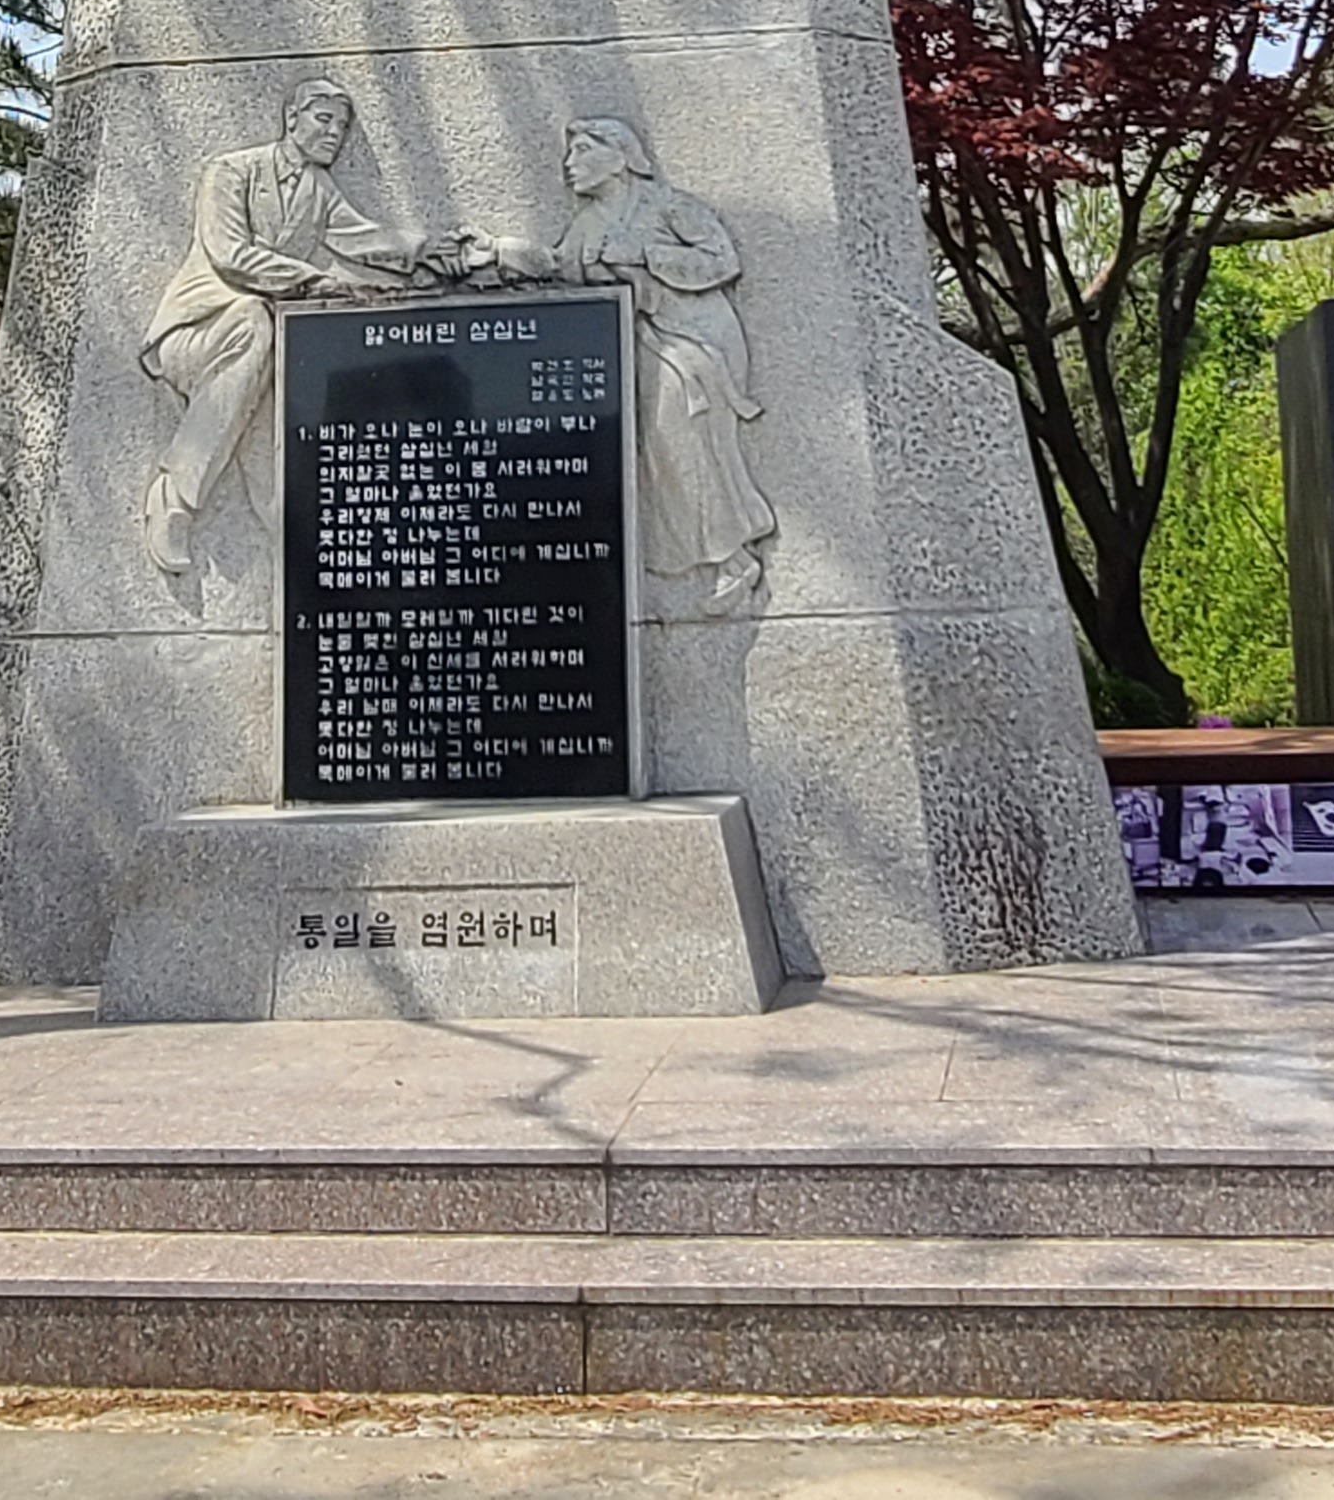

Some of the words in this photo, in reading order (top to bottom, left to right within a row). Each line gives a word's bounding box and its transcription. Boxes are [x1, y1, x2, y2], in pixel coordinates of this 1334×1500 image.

[365, 323, 457, 346] 잃어버린
[469, 319, 538, 342] 삼십년
[297, 426, 313, 441] 1.
[319, 424, 356, 439] 비가
[363, 422, 398, 438] 오나
[408, 420, 442, 437] 눈이
[453, 419, 487, 437] 오나
[497, 417, 549, 434] 바람이
[560, 415, 596, 431] 부나
[318, 444, 390, 461] 그리웠던
[400, 441, 453, 459] 삼십년
[463, 439, 498, 456] 세월
[319, 465, 390, 483] 의지할곳
[400, 463, 434, 480] 없는
[445, 461, 460, 478] 이
[471, 461, 487, 477] 몸
[498, 457, 588, 476] 서러워하며
[318, 488, 334, 504] 그
[345, 485, 399, 503] 얼마나
[408, 482, 497, 501] 울었던가요
[318, 507, 390, 525] 우리형제
[400, 504, 473, 522] 이제라도
[483, 503, 516, 519] 다시
[528, 500, 581, 517] 만나서
[318, 529, 373, 547] 못다한
[382, 527, 398, 544] 정
[408, 525, 480, 543] 나누는데
[318, 550, 372, 568] 어머님
[381, 548, 435, 566] 아버님
[445, 547, 461, 564] 그
[472, 544, 525, 562] 어디에
[536, 542, 610, 561] 계십니까
[318, 571, 390, 589] 목메이게
[400, 569, 435, 587] 불러
[445, 567, 501, 586] 봅니다
[296, 614, 312, 629] 2.
[318, 611, 391, 629] 내일일까
[400, 607, 474, 627] 모레일까
[483, 607, 537, 624] 기다린
[548, 605, 583, 622] 것이
[318, 633, 351, 652] 눈물
[363, 632, 397, 650] 맺힌
[408, 631, 462, 649] 삼십년
[473, 629, 507, 646] 세월
[318, 655, 390, 674] 고향잃은
[401, 654, 416, 671] 이
[427, 651, 480, 670] 신세를
[492, 649, 584, 668] 서러워하며
[318, 677, 334, 695] 그
[344, 675, 399, 693] 얼마나
[408, 672, 499, 691] 울었던가요
[318, 699, 352, 717] 우리
[363, 698, 397, 715] 남매
[409, 695, 481, 714] 이제라도
[492, 694, 527, 711] 다시
[538, 692, 593, 711] 만나서
[318, 720, 373, 738] 못다한
[382, 719, 398, 736] 정
[408, 717, 482, 734] 나누는데
[318, 742, 372, 760] 어머님
[381, 739, 436, 758] 아버님
[446, 739, 462, 757] 그
[473, 737, 527, 755] 어디에
[539, 735, 613, 754] 계십니까
[318, 763, 390, 782] 목메이게
[400, 762, 436, 780] 불러
[446, 760, 502, 779] 봅니다
[295, 911, 397, 949] 통일을
[421, 909, 558, 948] 염원하며
